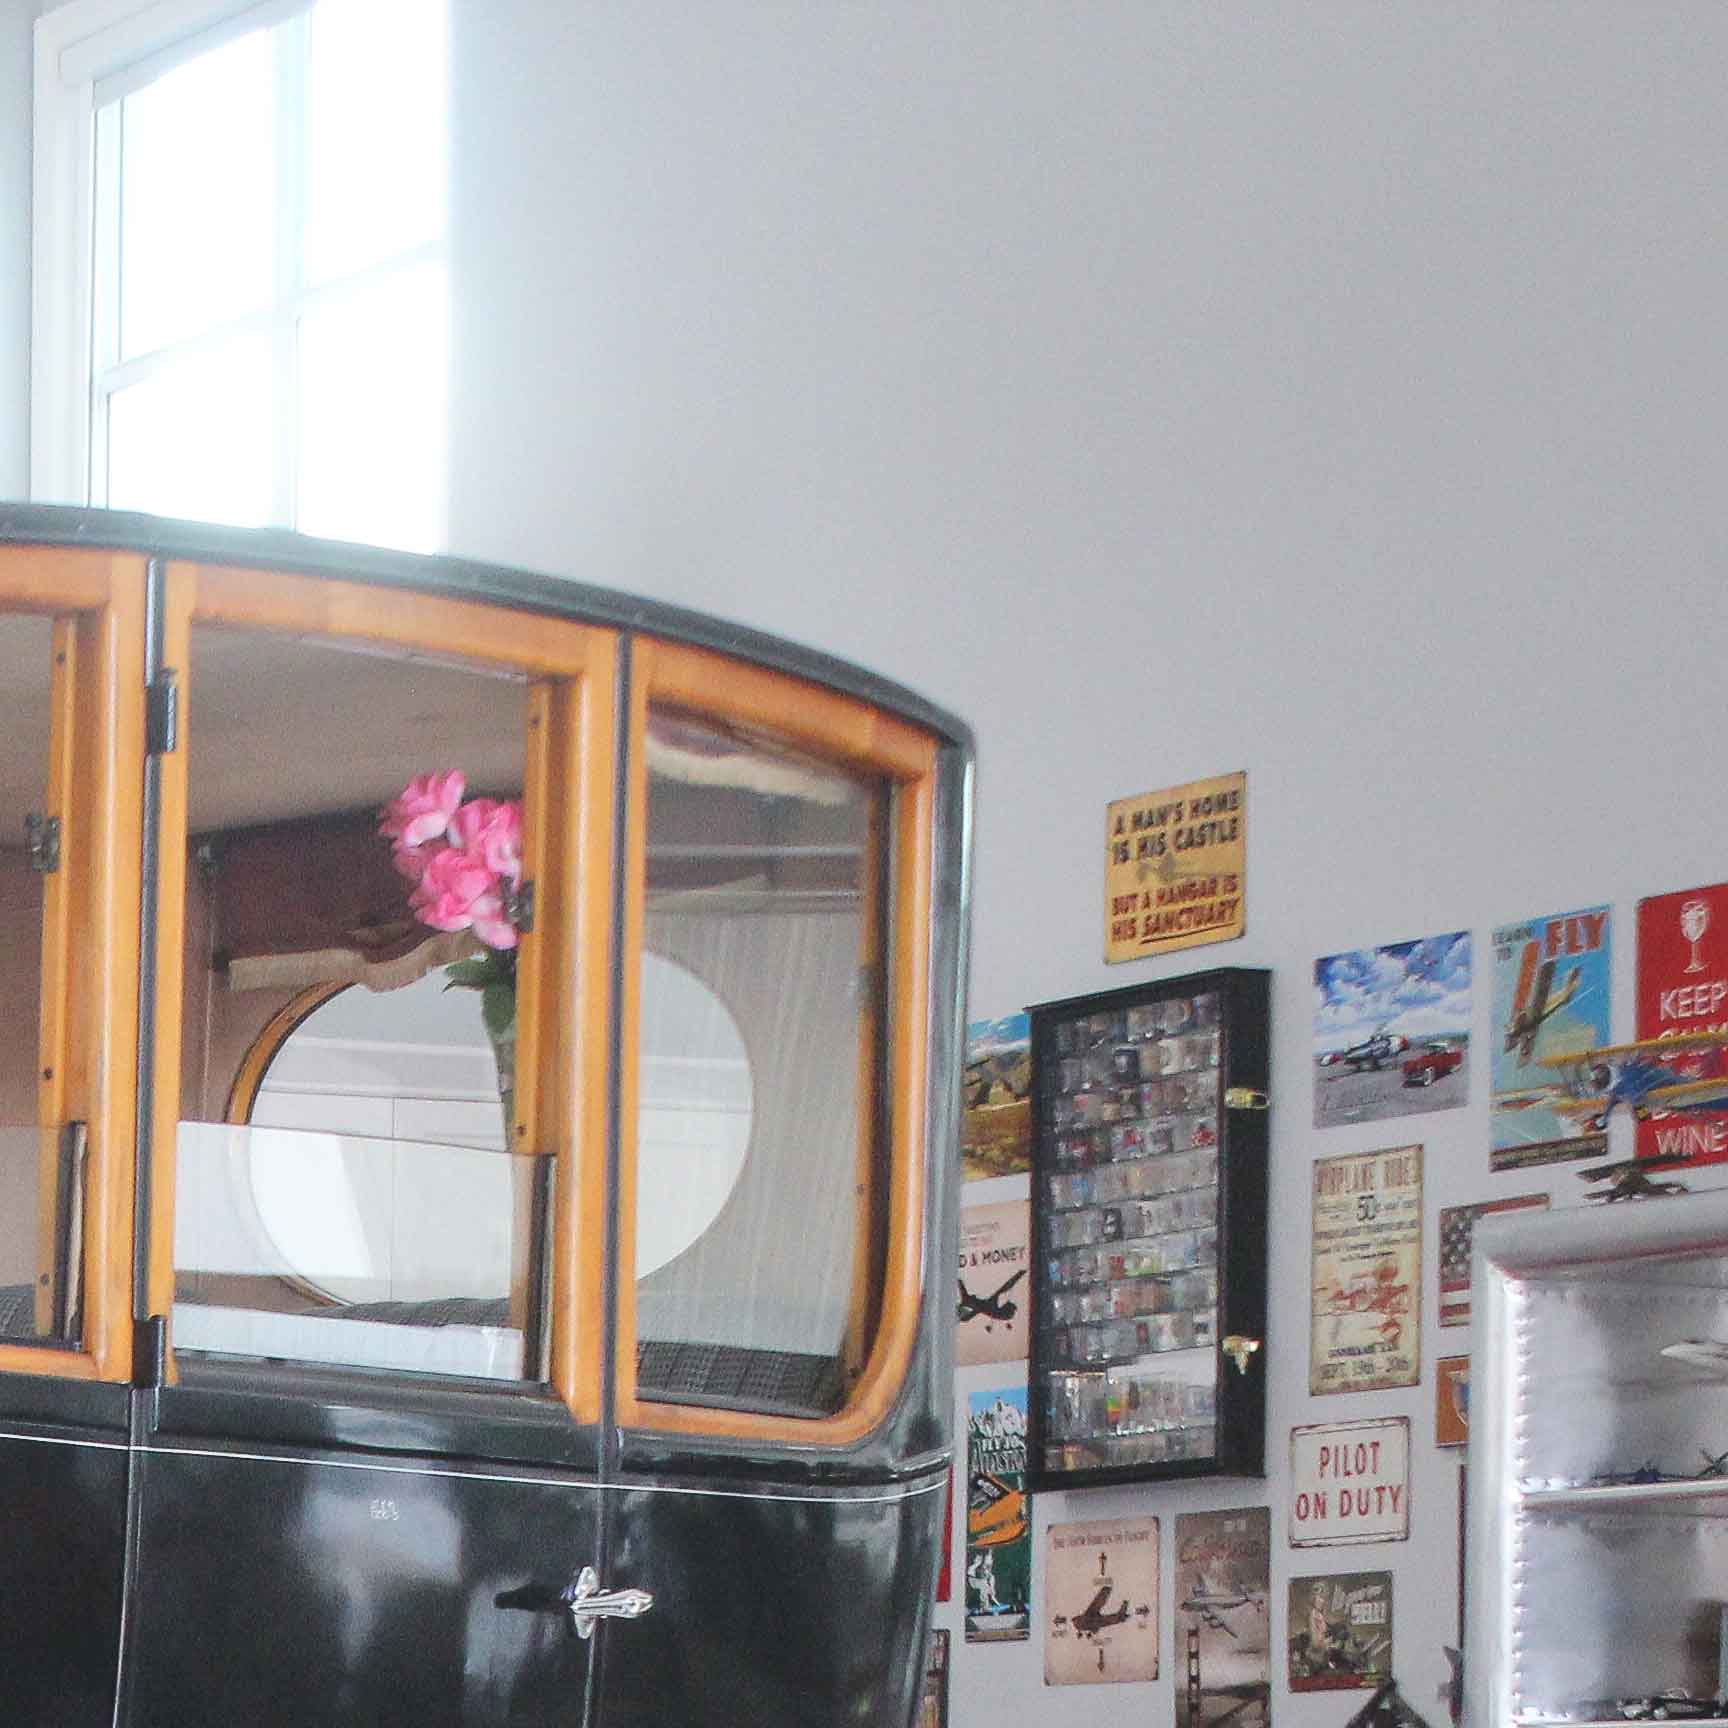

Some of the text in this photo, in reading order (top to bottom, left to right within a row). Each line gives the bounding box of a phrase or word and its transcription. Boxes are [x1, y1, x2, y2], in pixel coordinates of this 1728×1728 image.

[1115, 789, 1239, 834] A MAN'S HOME
[1113, 816, 1238, 865] IS HIS CASTLE
[1545, 911, 1609, 958] FLY
[1659, 981, 1728, 1022] KEEP
[1655, 1120, 1728, 1156] WINE
[1319, 1441, 1380, 1479] PILOT
[1295, 1485, 1402, 1520] ON DUTY
